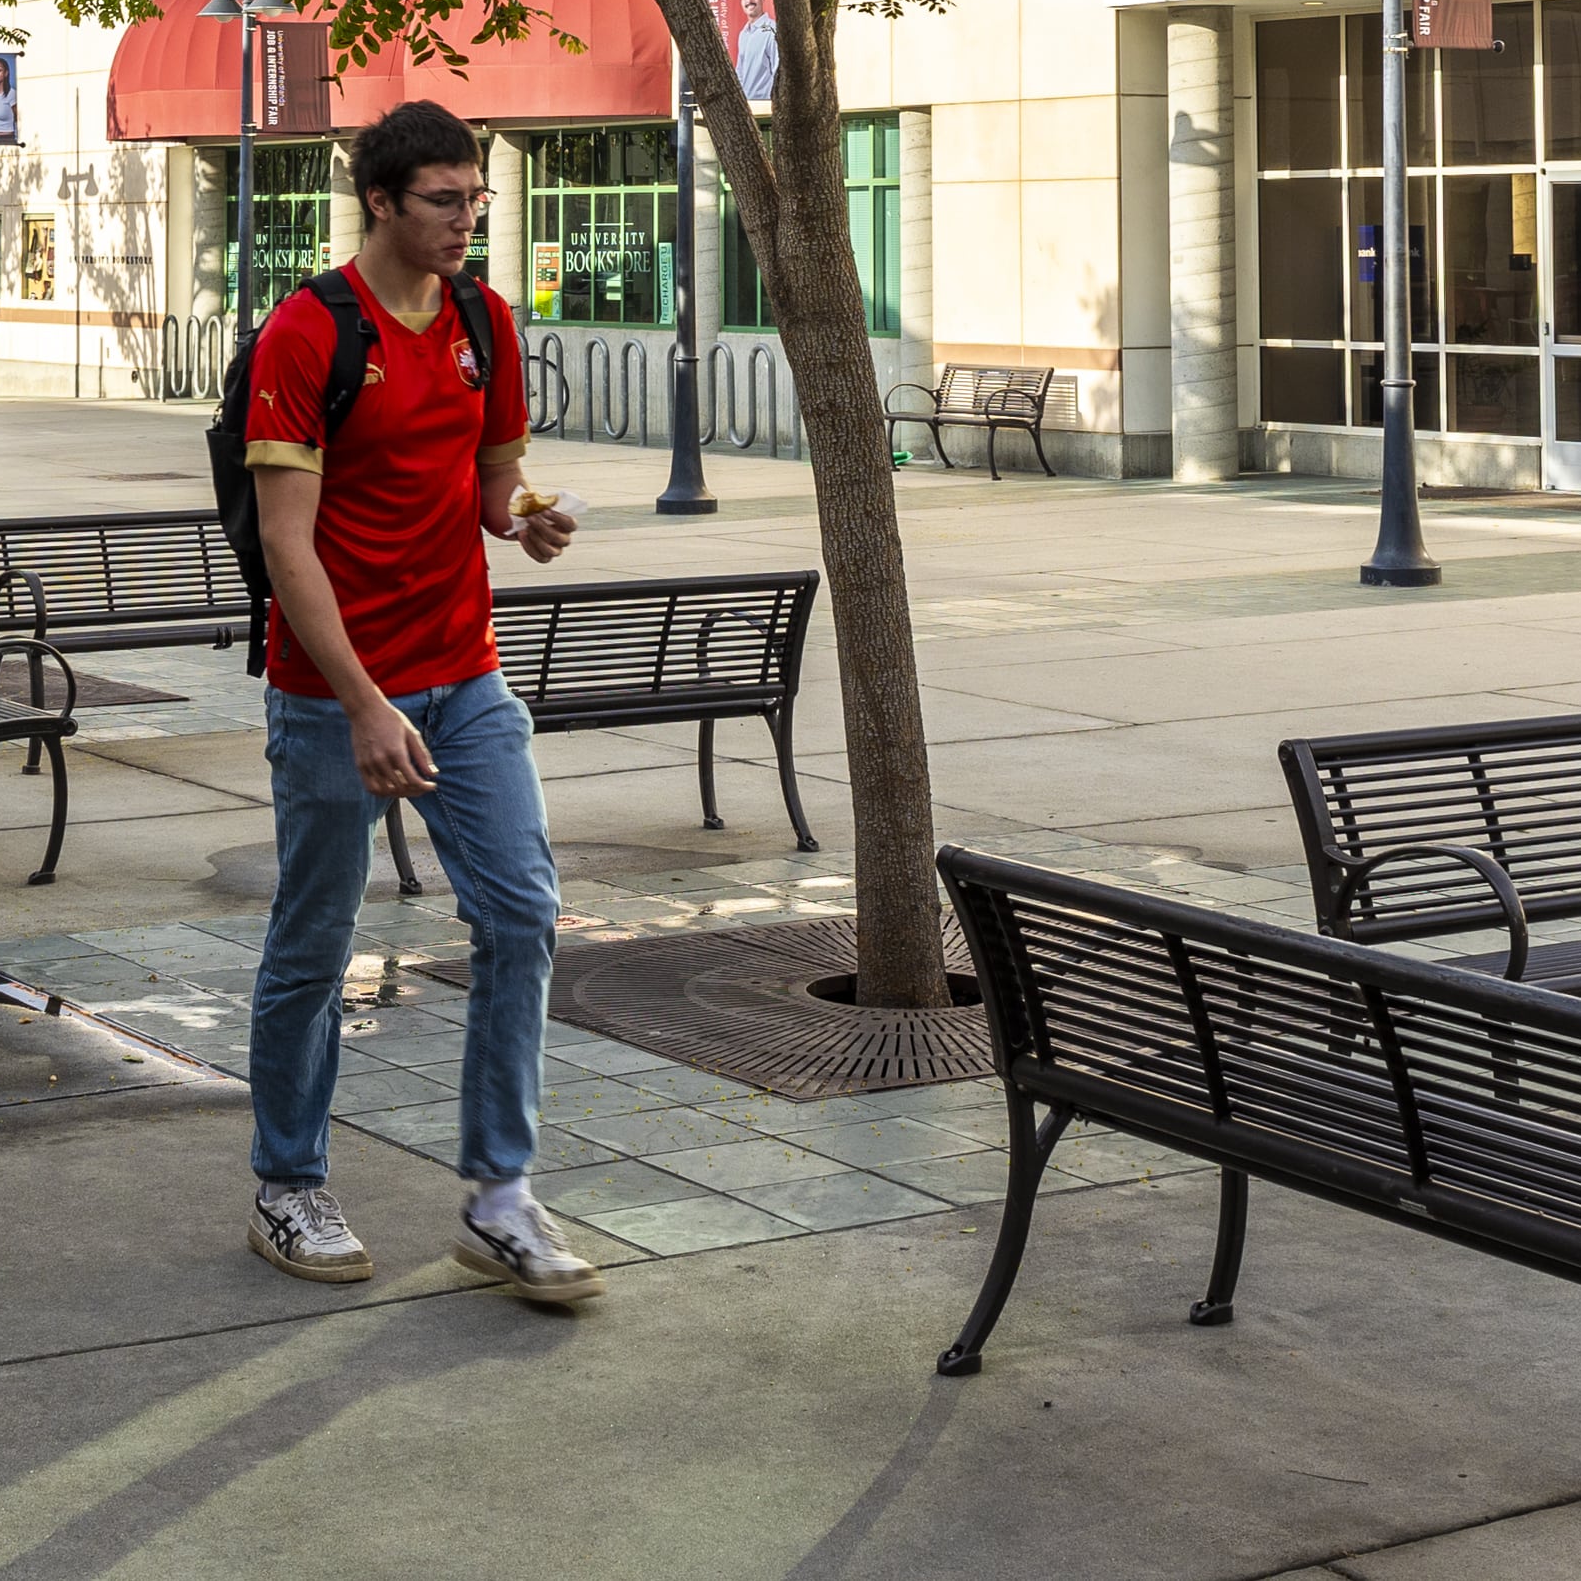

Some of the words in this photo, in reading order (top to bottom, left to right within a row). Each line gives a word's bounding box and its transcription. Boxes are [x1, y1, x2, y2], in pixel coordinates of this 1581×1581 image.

[1419, 6, 1431, 36] FAIR
[267, 30, 276, 46] JOB
[267, 55, 278, 104] INTERNSHIP
[268, 106, 279, 125] FAIR
[565, 250, 651, 273] BOOKSTORE
